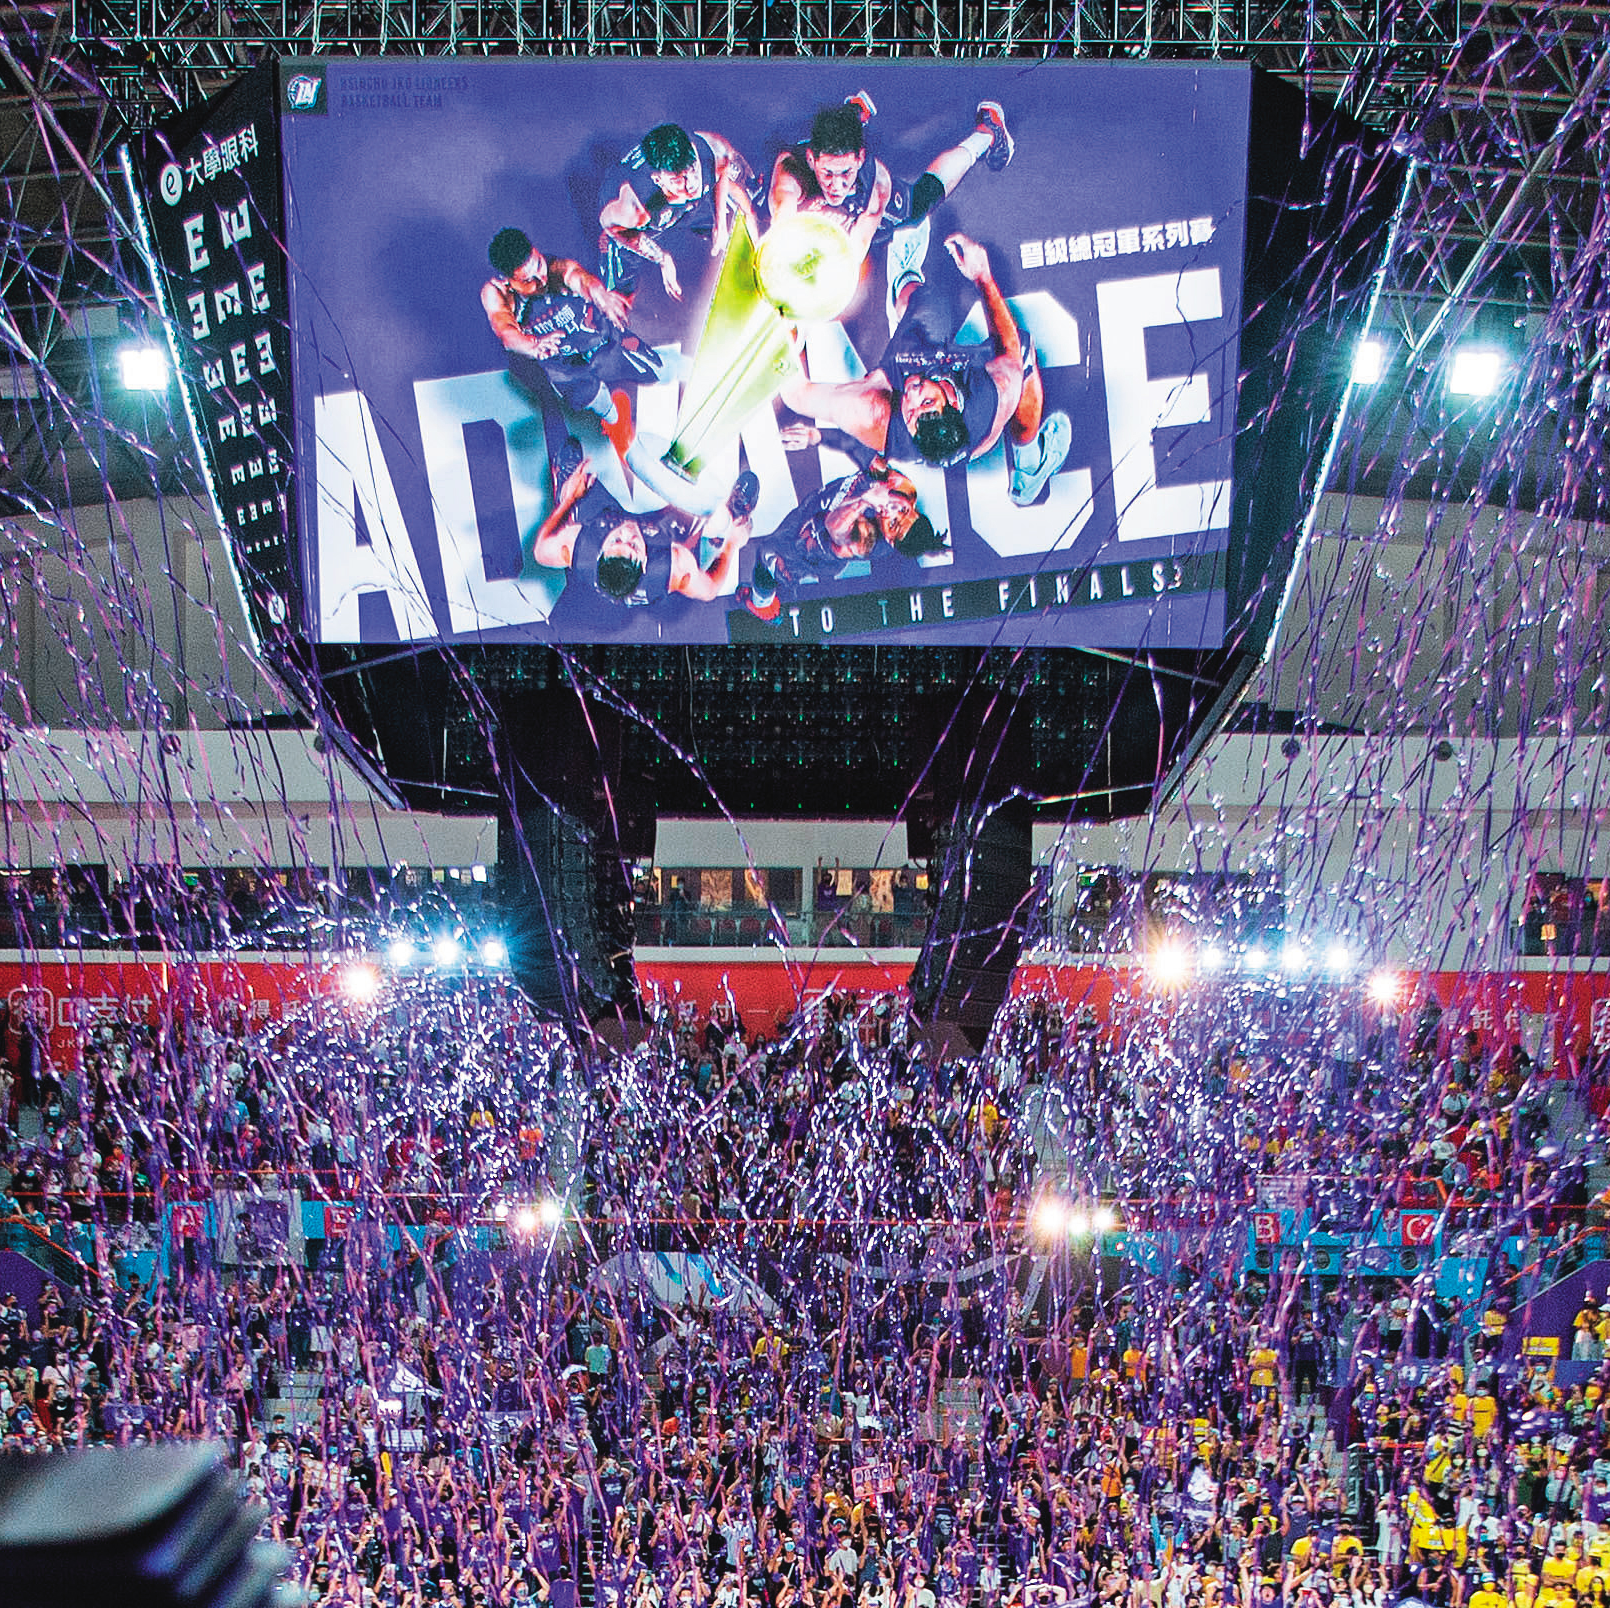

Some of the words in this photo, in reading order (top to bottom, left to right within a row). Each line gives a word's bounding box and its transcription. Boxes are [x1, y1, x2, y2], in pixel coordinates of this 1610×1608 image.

[186, 123, 258, 192] 大學眼科
[789, 607, 835, 637] TO
[876, 590, 955, 626] THE
[998, 564, 1167, 611] FINALS
[1255, 1215, 1274, 1239] B
